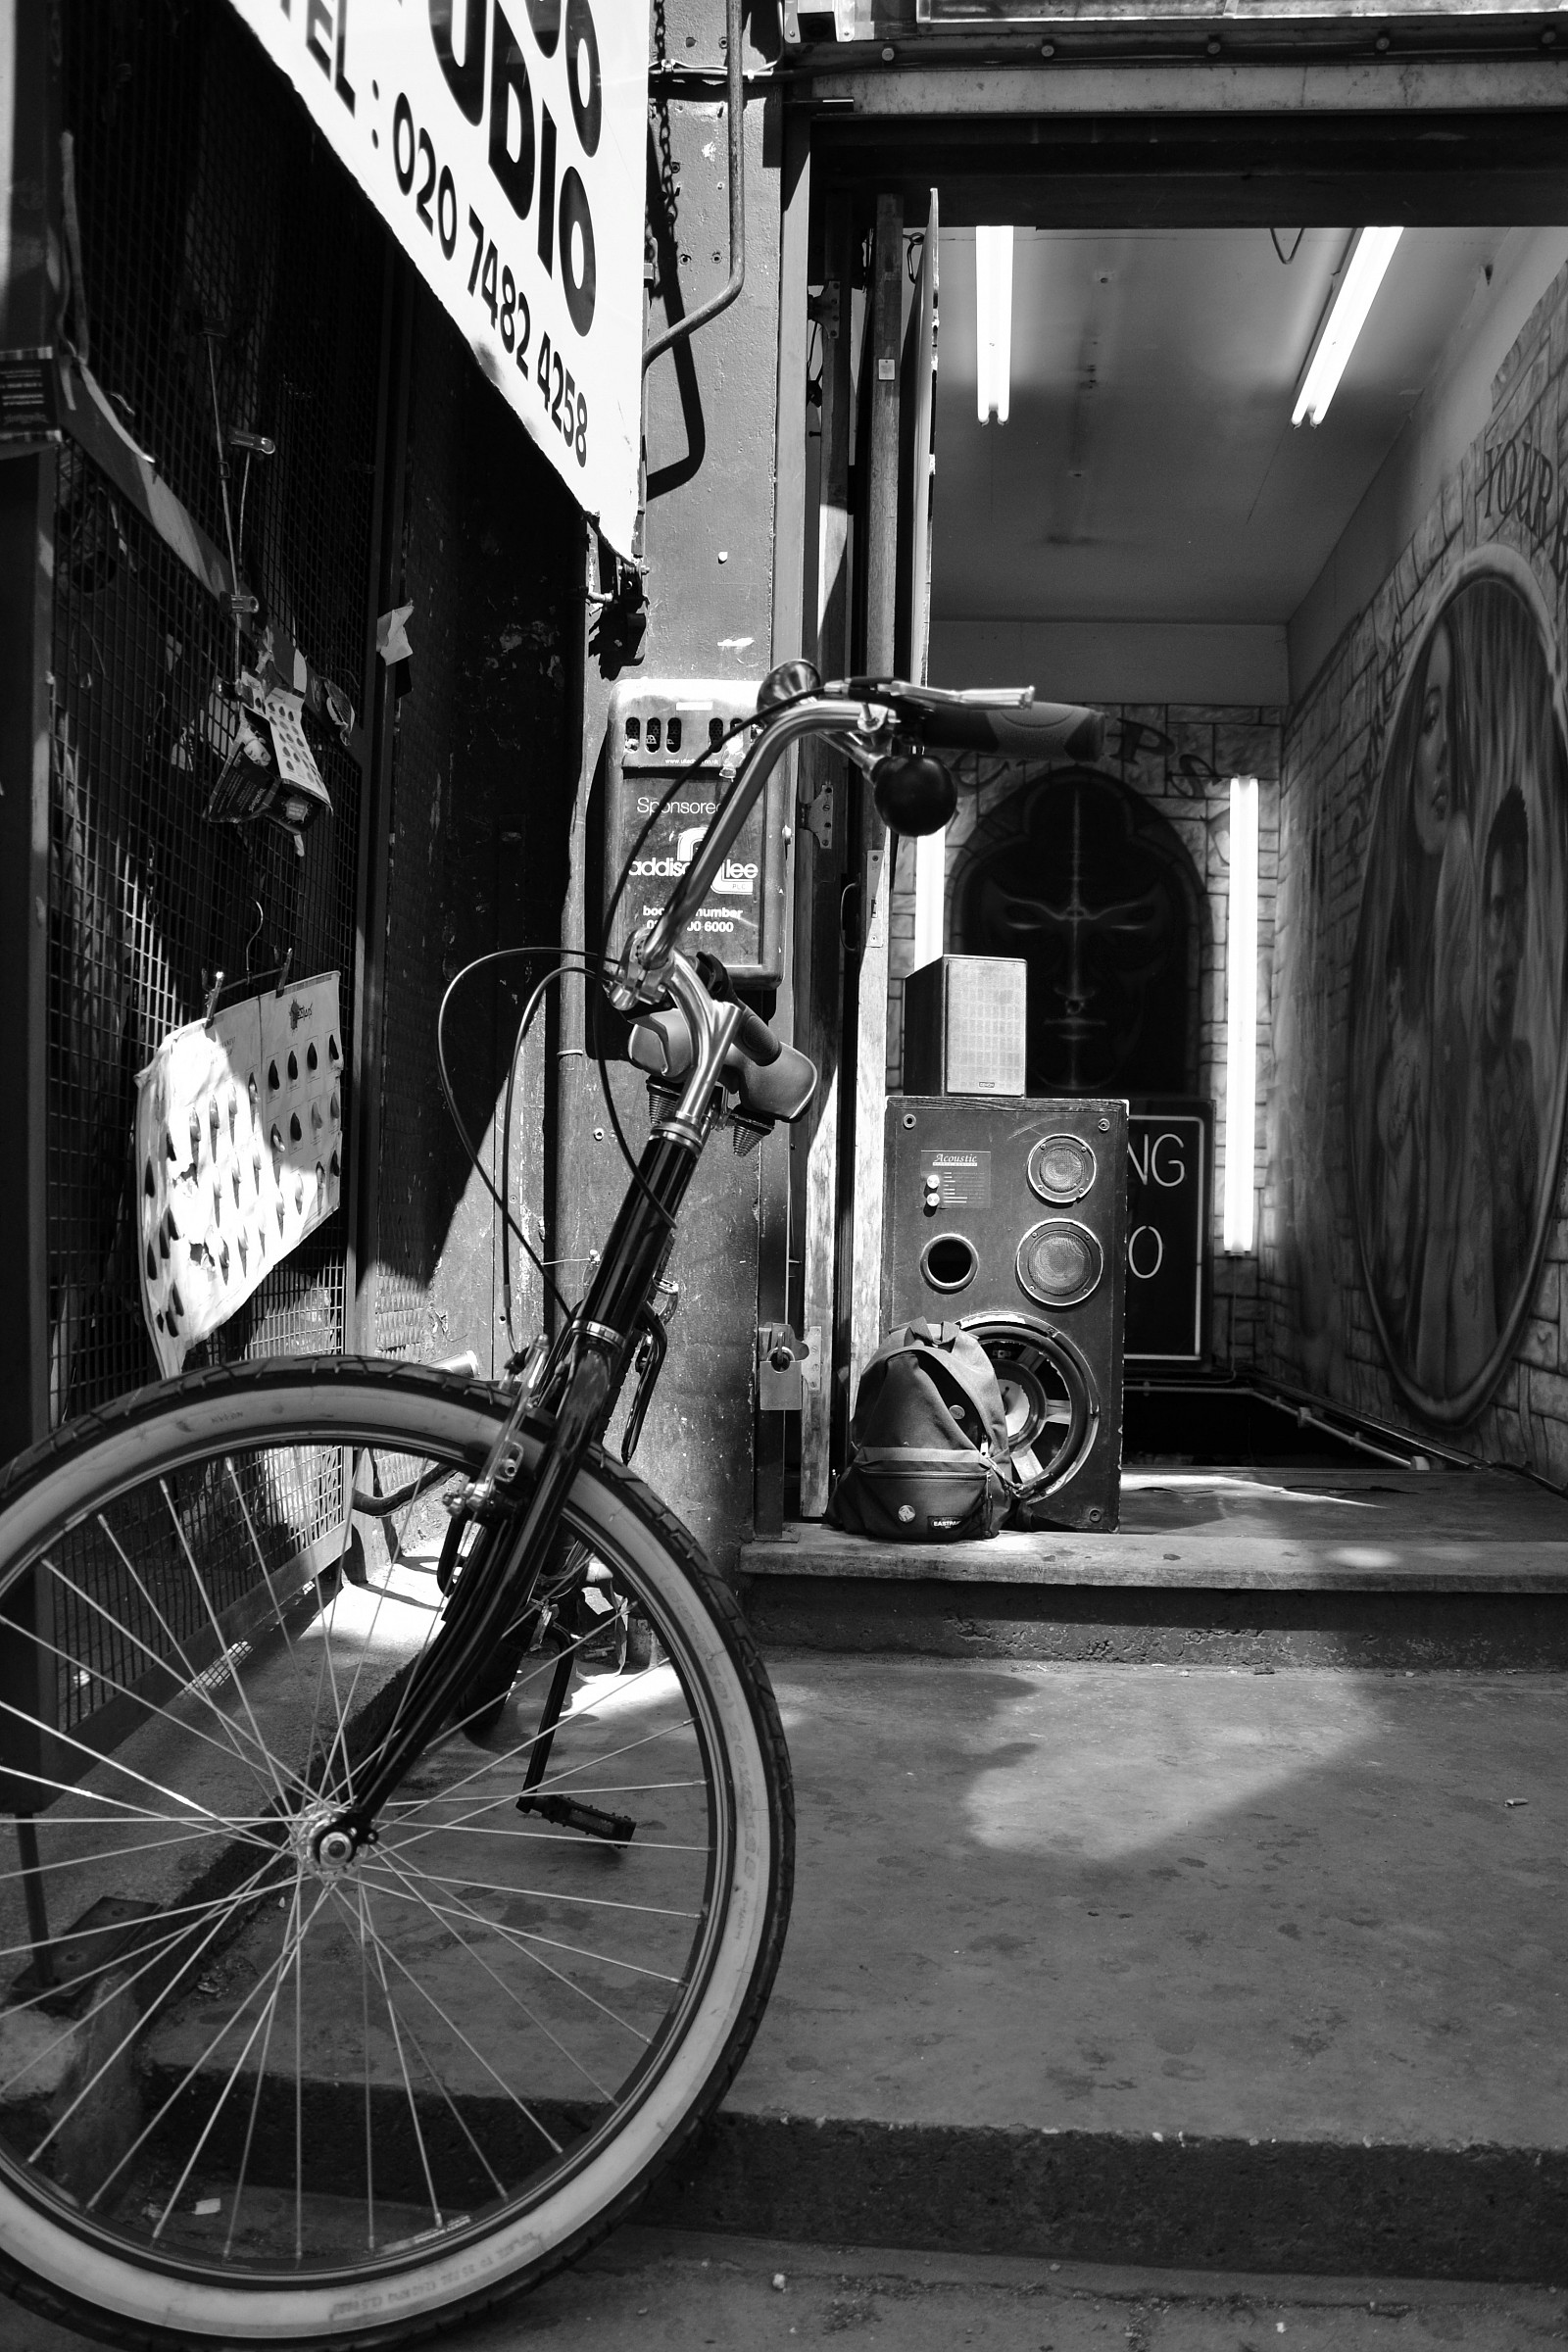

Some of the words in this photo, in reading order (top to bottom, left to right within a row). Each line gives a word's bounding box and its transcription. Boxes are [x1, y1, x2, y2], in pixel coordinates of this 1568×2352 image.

[393, 91, 457, 261] 020
[467, 204, 530, 380] 7482
[536, 331, 587, 468] 4258
[637, 797, 721, 815] Sponsore
[628, 858, 691, 877] addis
[725, 859, 759, 879] lee
[704, 921, 734, 932] 6000
[934, 1153, 978, 1163] Acoustic
